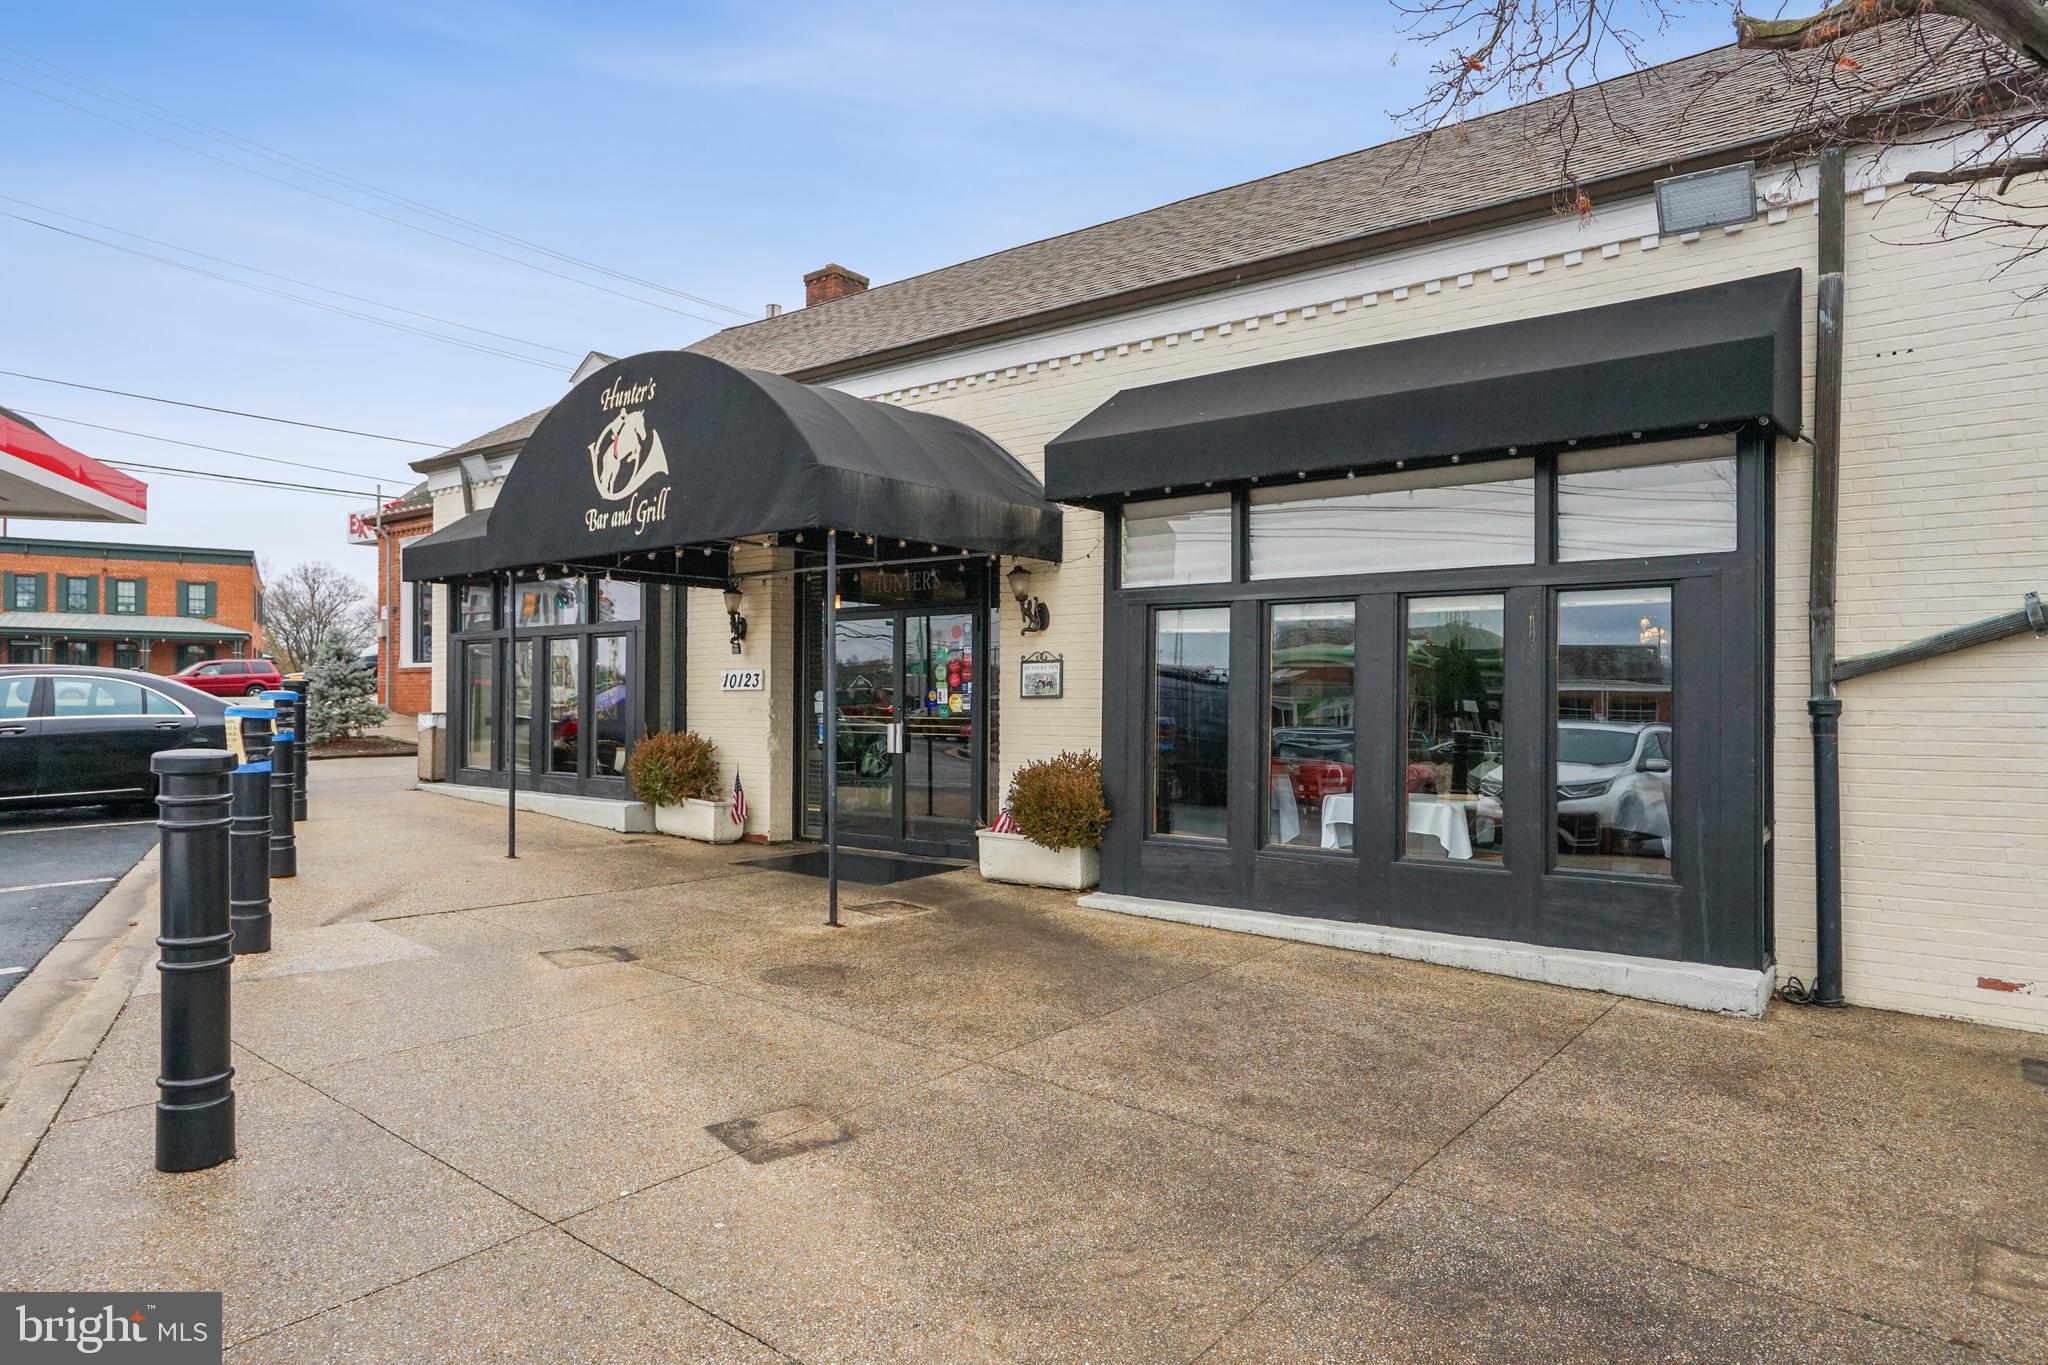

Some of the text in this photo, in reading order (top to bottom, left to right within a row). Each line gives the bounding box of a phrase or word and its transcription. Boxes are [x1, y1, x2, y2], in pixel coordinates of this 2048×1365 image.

[600, 376, 657, 411] Hunter's
[585, 487, 671, 536] Bar and Grill
[723, 673, 760, 688] 10123
